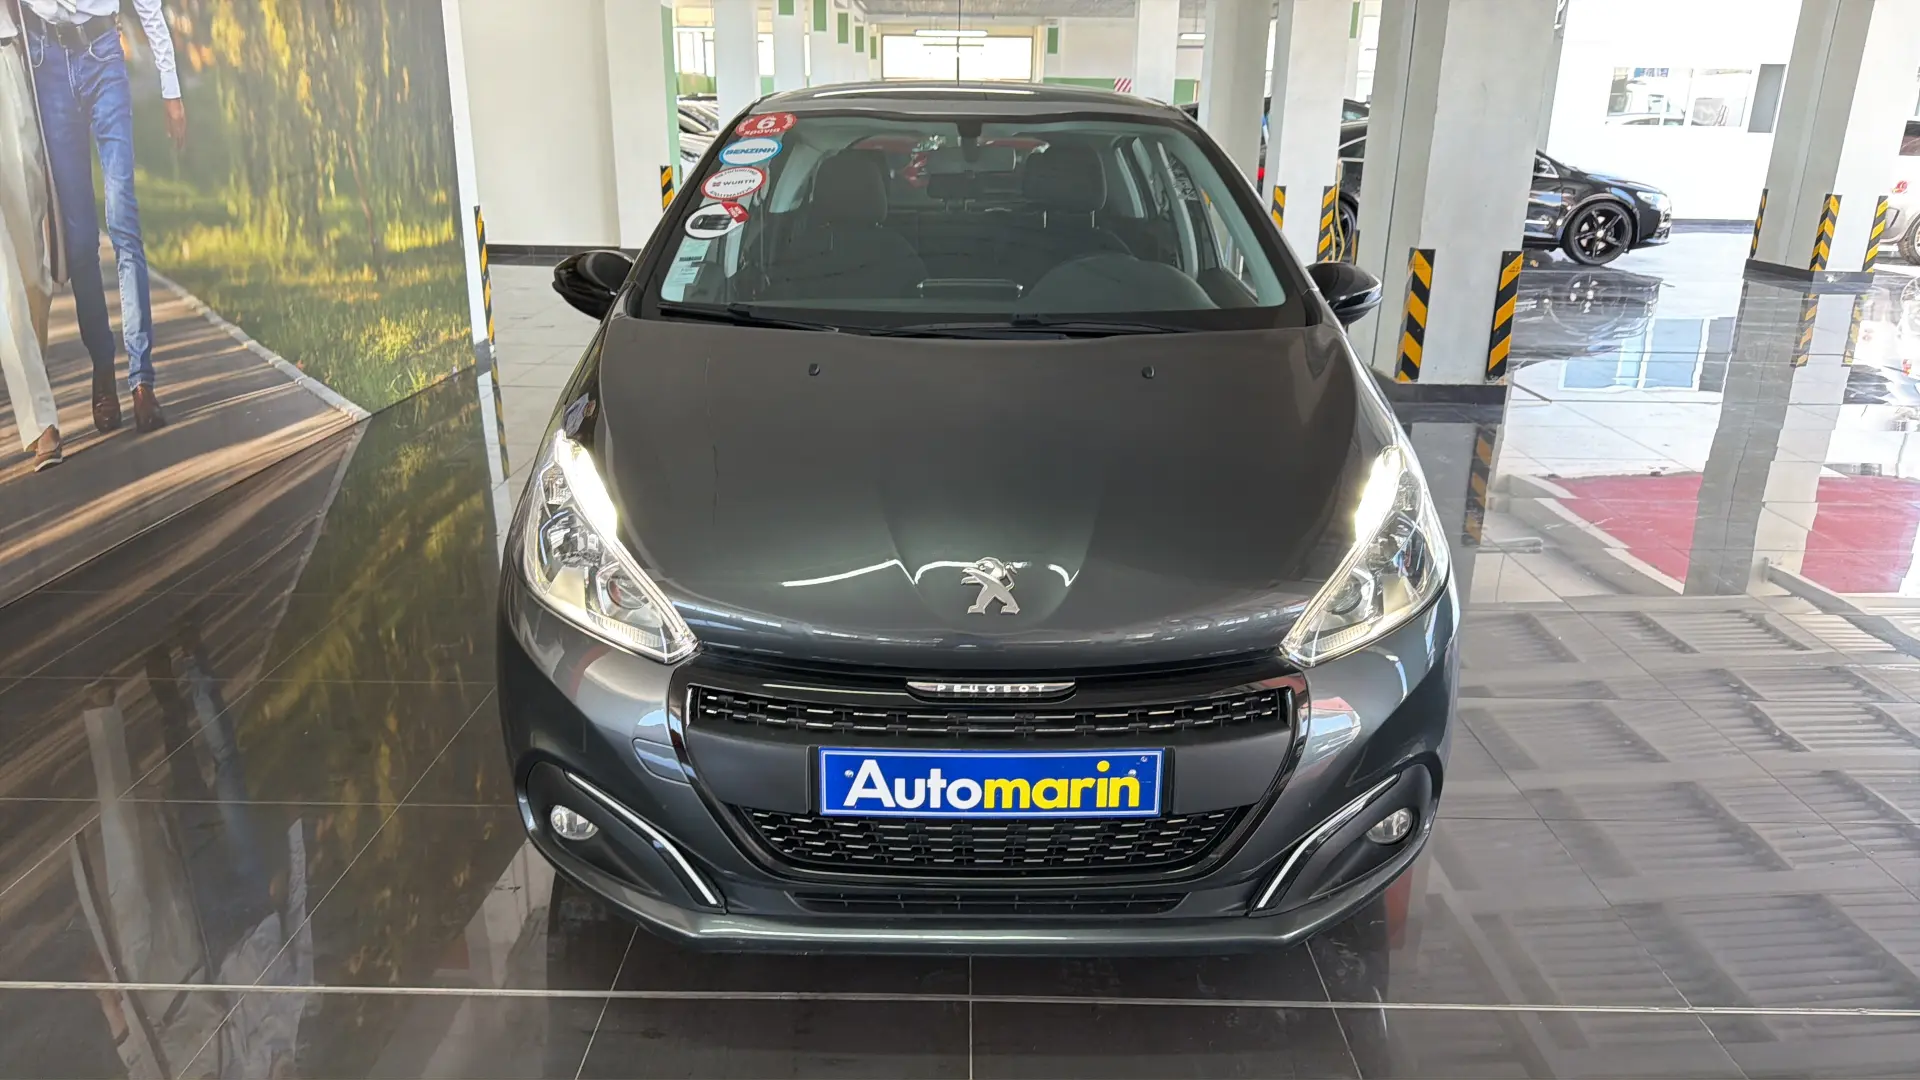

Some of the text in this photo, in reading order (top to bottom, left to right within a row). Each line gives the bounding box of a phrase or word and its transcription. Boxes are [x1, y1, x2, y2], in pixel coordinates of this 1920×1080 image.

[756, 116, 777, 130] 6
[936, 683, 1045, 693] PEUGEOT
[842, 759, 1141, 810] Automarin
